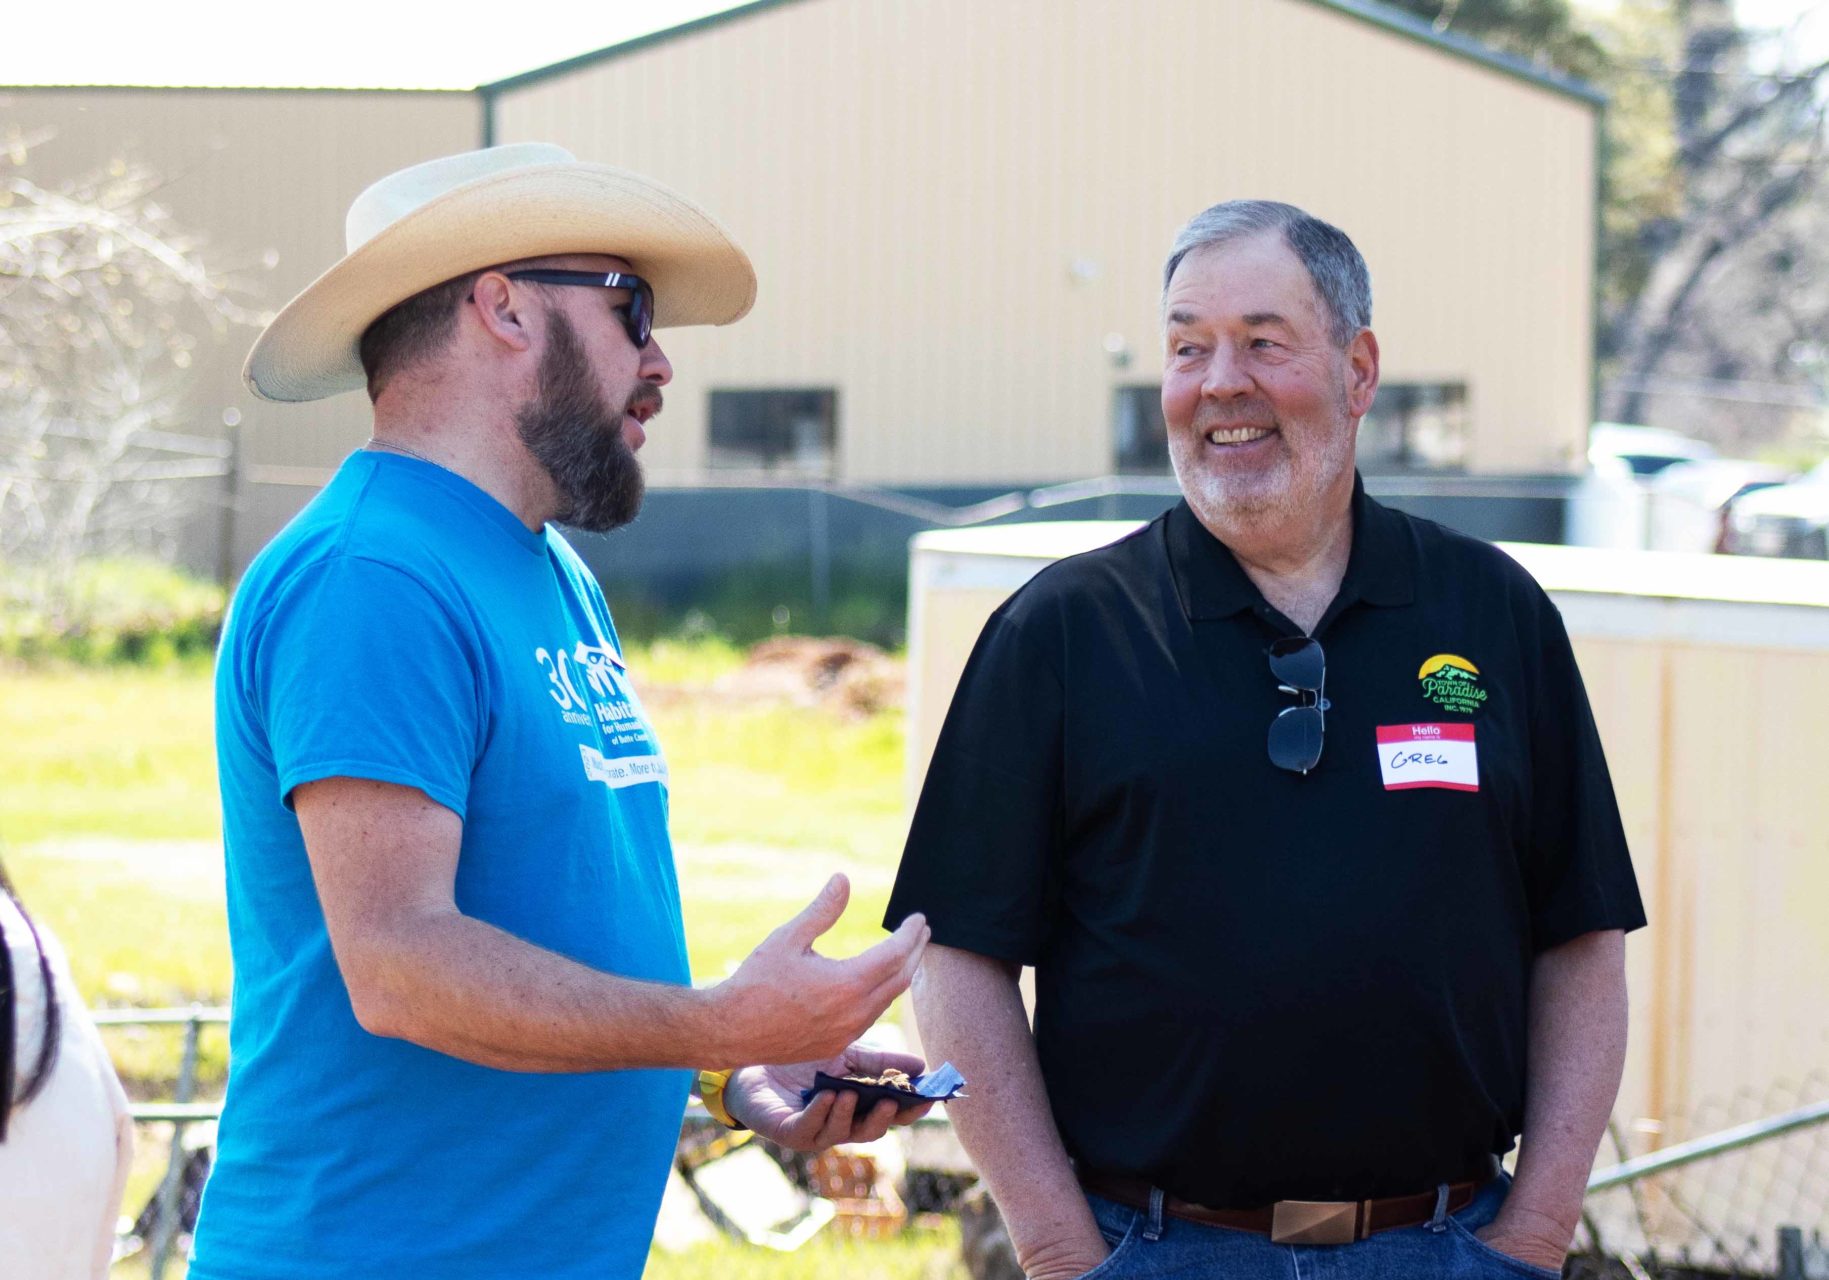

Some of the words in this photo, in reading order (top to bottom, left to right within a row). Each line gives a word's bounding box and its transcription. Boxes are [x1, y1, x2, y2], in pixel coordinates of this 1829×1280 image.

[1423, 678, 1488, 701] Paradise
[1433, 696, 1480, 708] CALIFORNIA
[594, 701, 635, 722] Habit
[1412, 726, 1441, 736] Hello
[1391, 751, 1448, 769] GREG
